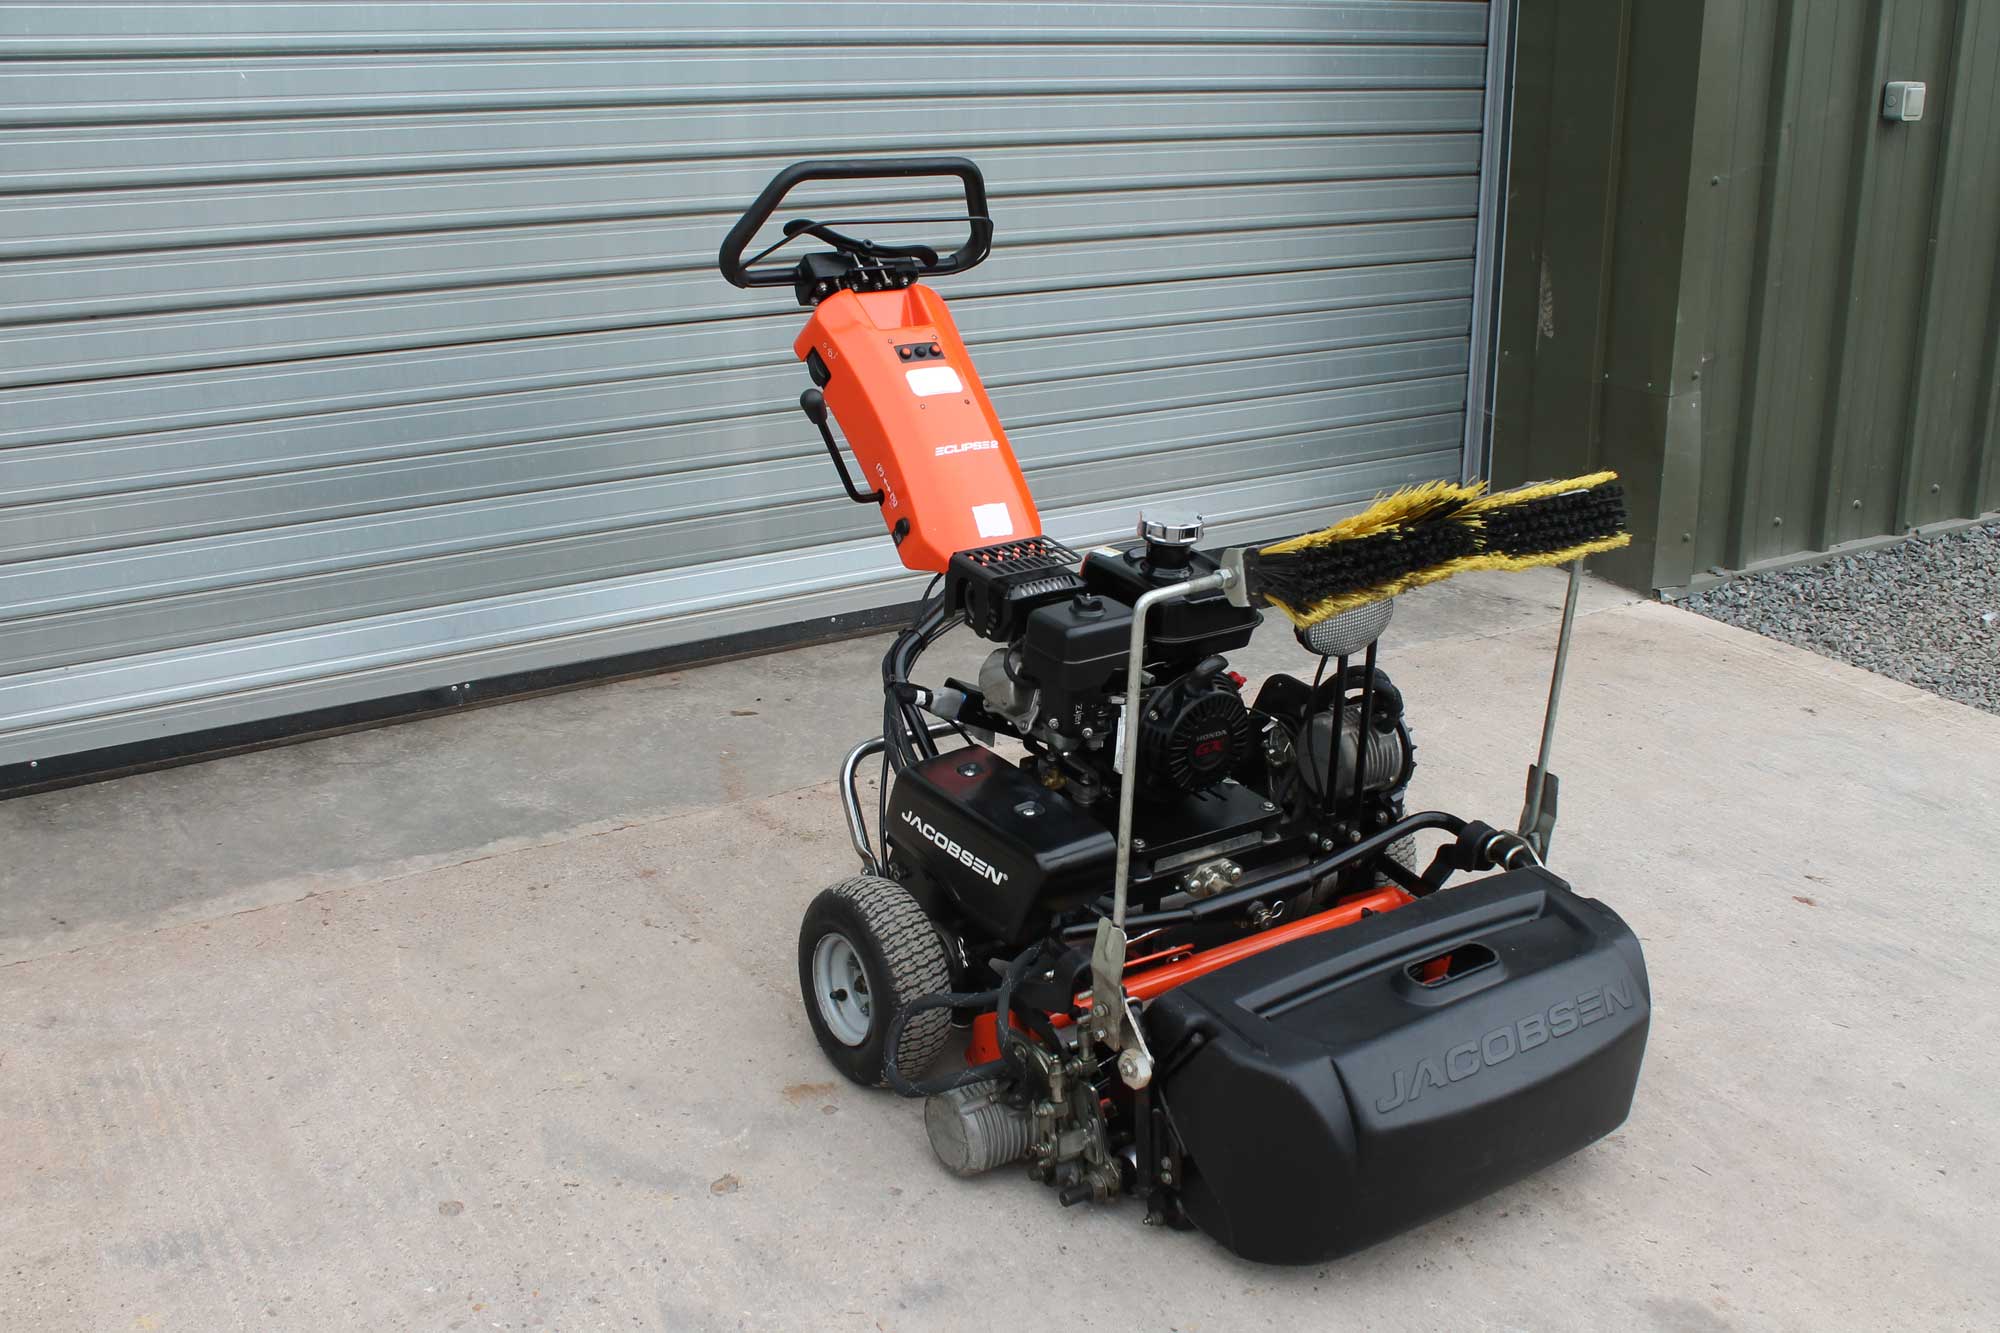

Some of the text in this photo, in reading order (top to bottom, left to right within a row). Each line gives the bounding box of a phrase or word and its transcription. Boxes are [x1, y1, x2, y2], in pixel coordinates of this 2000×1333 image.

[935, 440, 990, 456] ECLIPSE
[1196, 729, 1228, 741] HONDA
[1375, 977, 1634, 1114] JACOBSEN
